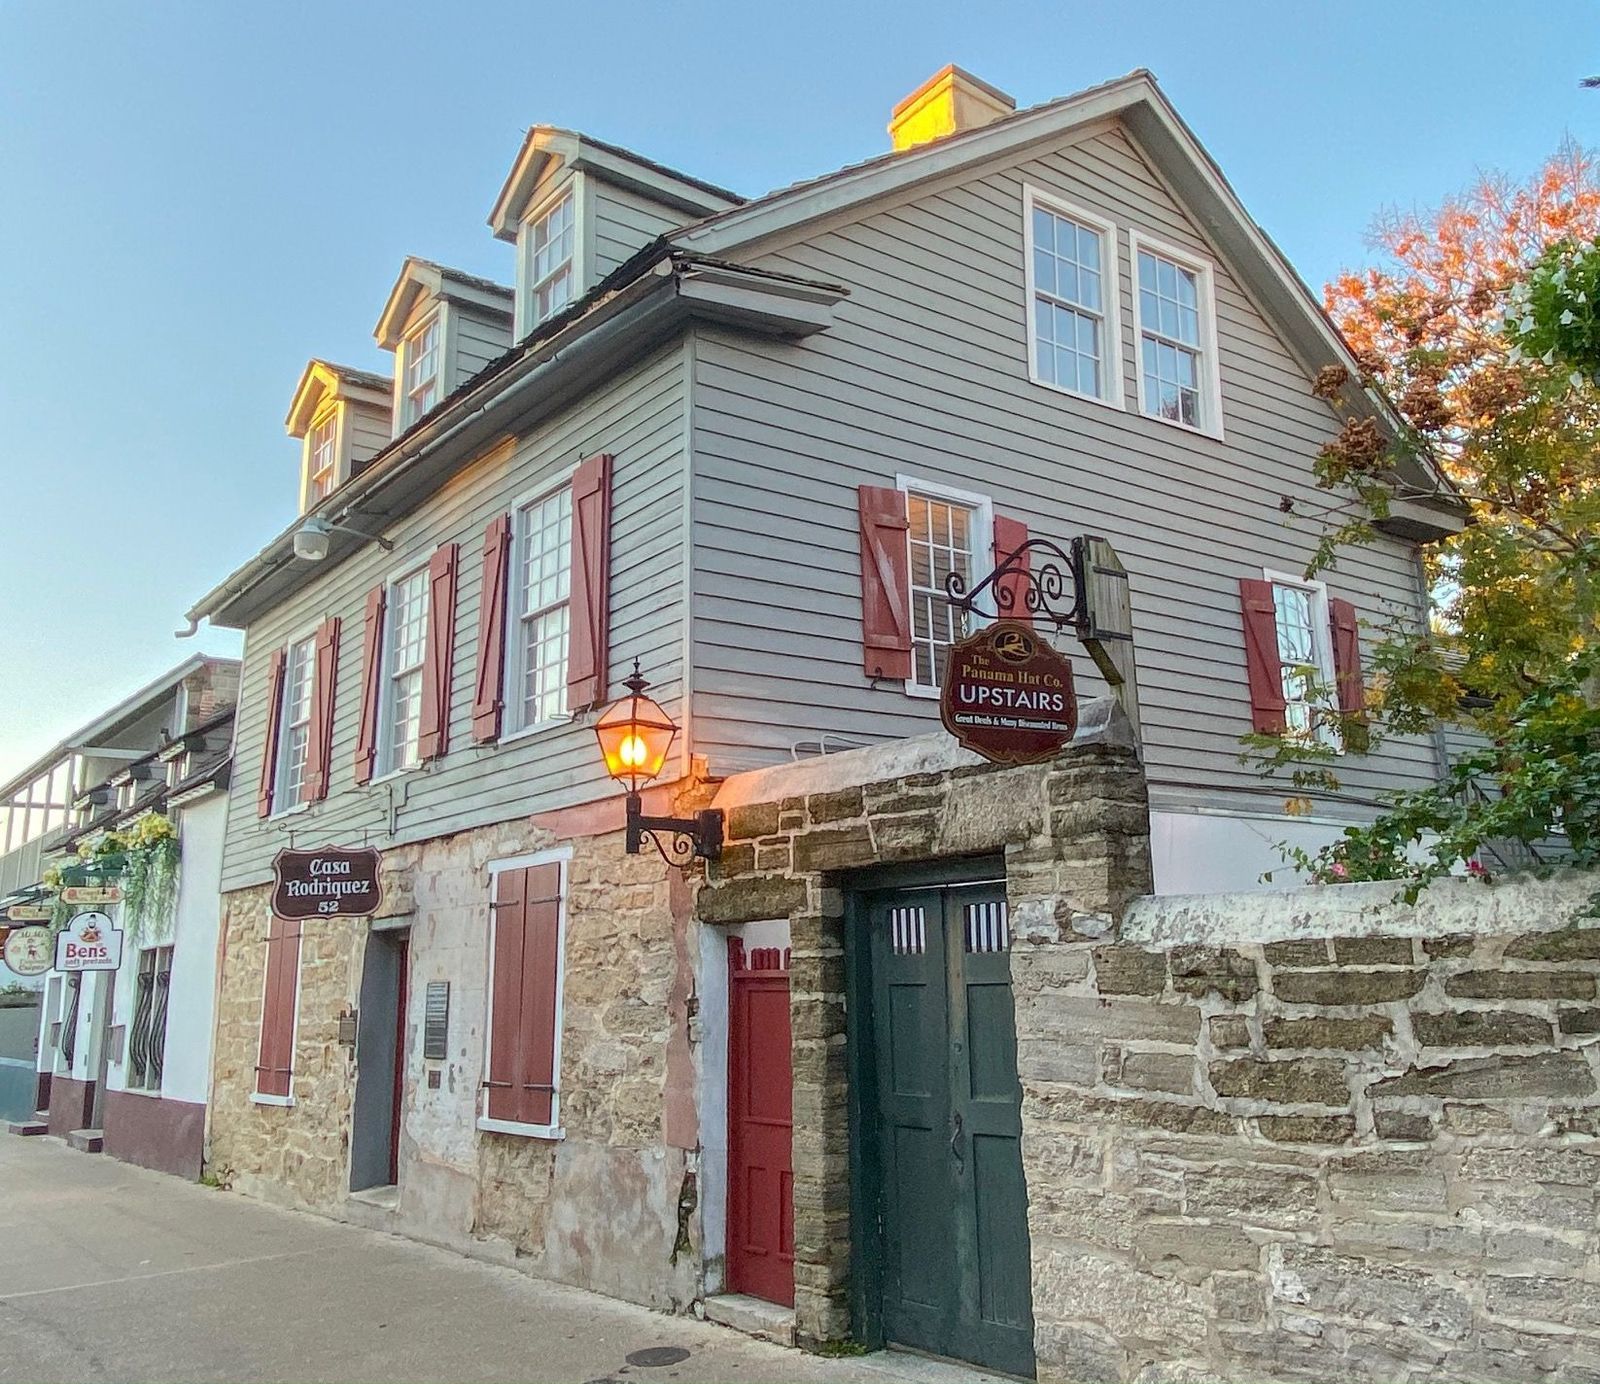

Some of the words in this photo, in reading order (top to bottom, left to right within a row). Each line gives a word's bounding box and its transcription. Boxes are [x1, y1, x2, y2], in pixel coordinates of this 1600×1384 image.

[971, 655, 990, 666] The
[962, 664, 1014, 683] Panama
[1018, 670, 1040, 685] Hat
[1043, 673, 1065, 688] Co.
[960, 684, 1064, 711] UPSTAIRS
[309, 858, 351, 877] Casa
[317, 900, 339, 913] 52
